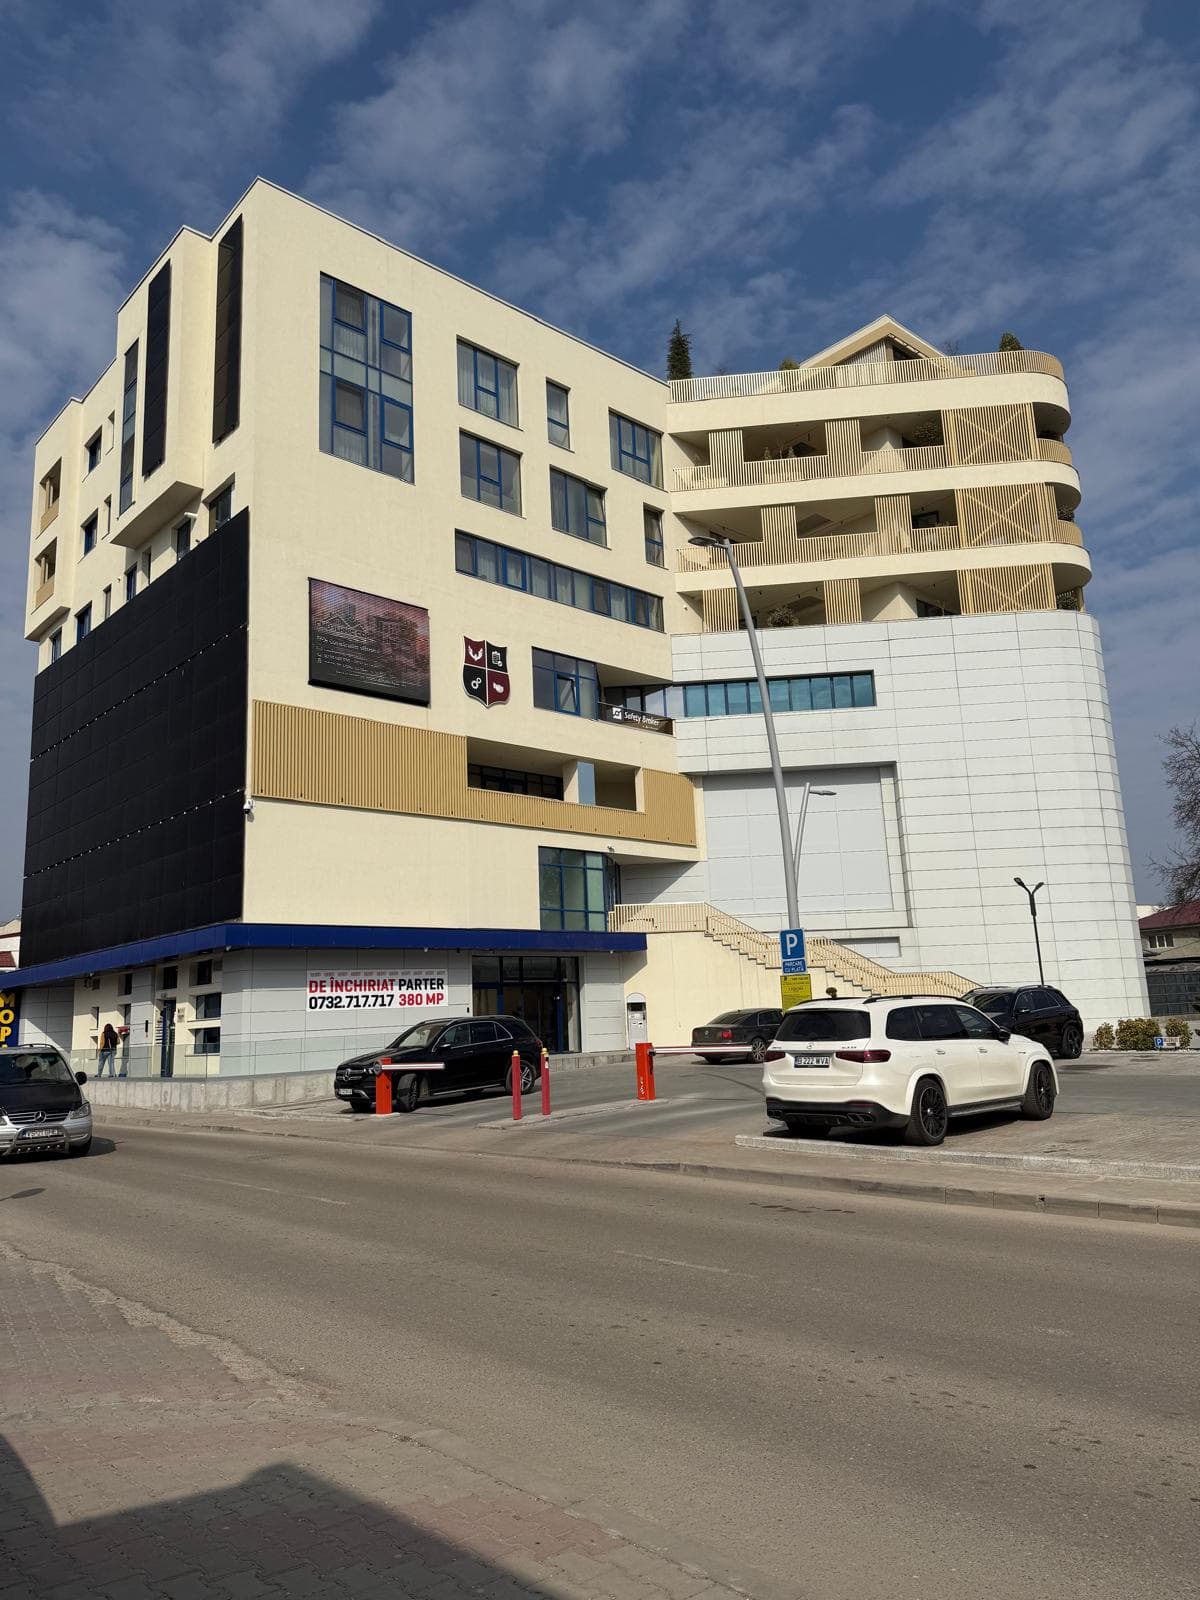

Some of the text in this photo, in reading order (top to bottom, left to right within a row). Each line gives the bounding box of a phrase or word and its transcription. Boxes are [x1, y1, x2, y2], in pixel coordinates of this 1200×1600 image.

[624, 711, 659, 726] Safety Broker
[786, 933, 798, 956] P
[309, 976, 444, 993] DE ÎNCHIRIAT PARTER
[309, 992, 444, 1009] 0732.717.717 380 MP
[0, 992, 15, 1048] MOP
